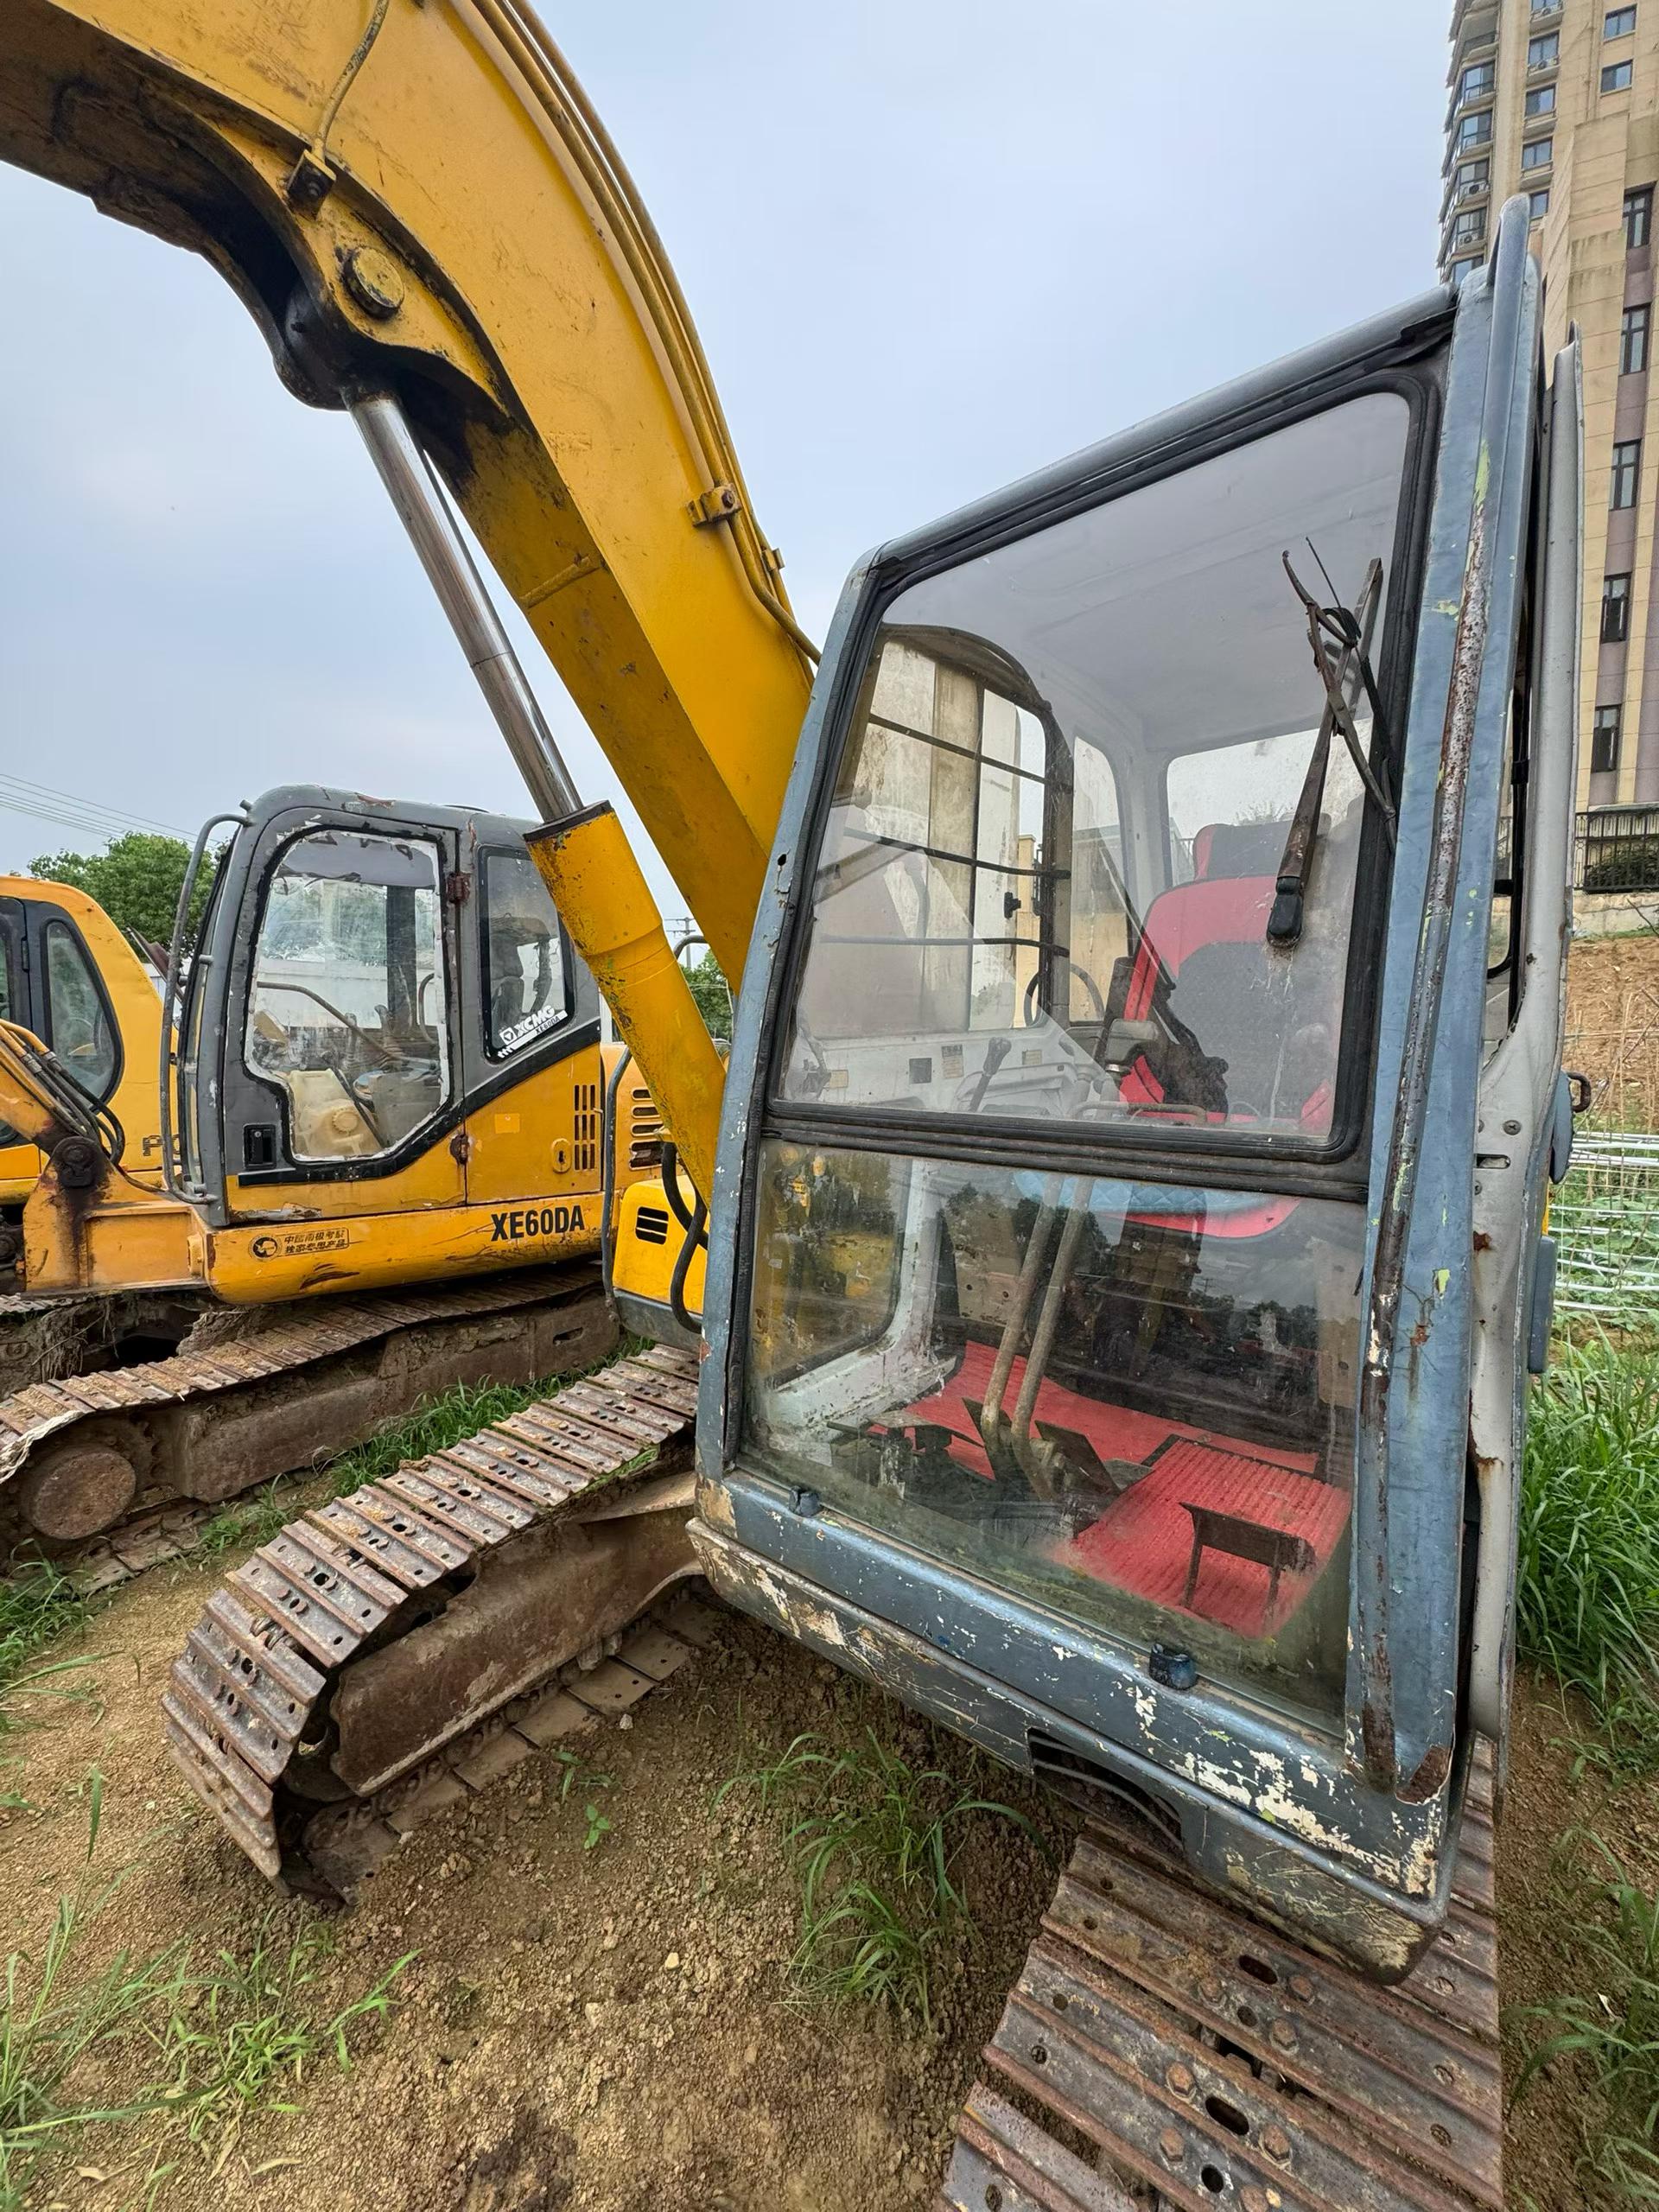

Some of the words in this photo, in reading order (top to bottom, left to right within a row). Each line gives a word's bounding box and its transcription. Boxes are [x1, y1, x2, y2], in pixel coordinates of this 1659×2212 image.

[514, 1005, 555, 1037] XCMG
[535, 1015, 561, 1034] XE60DA
[491, 1205, 585, 1242] XE60DA
